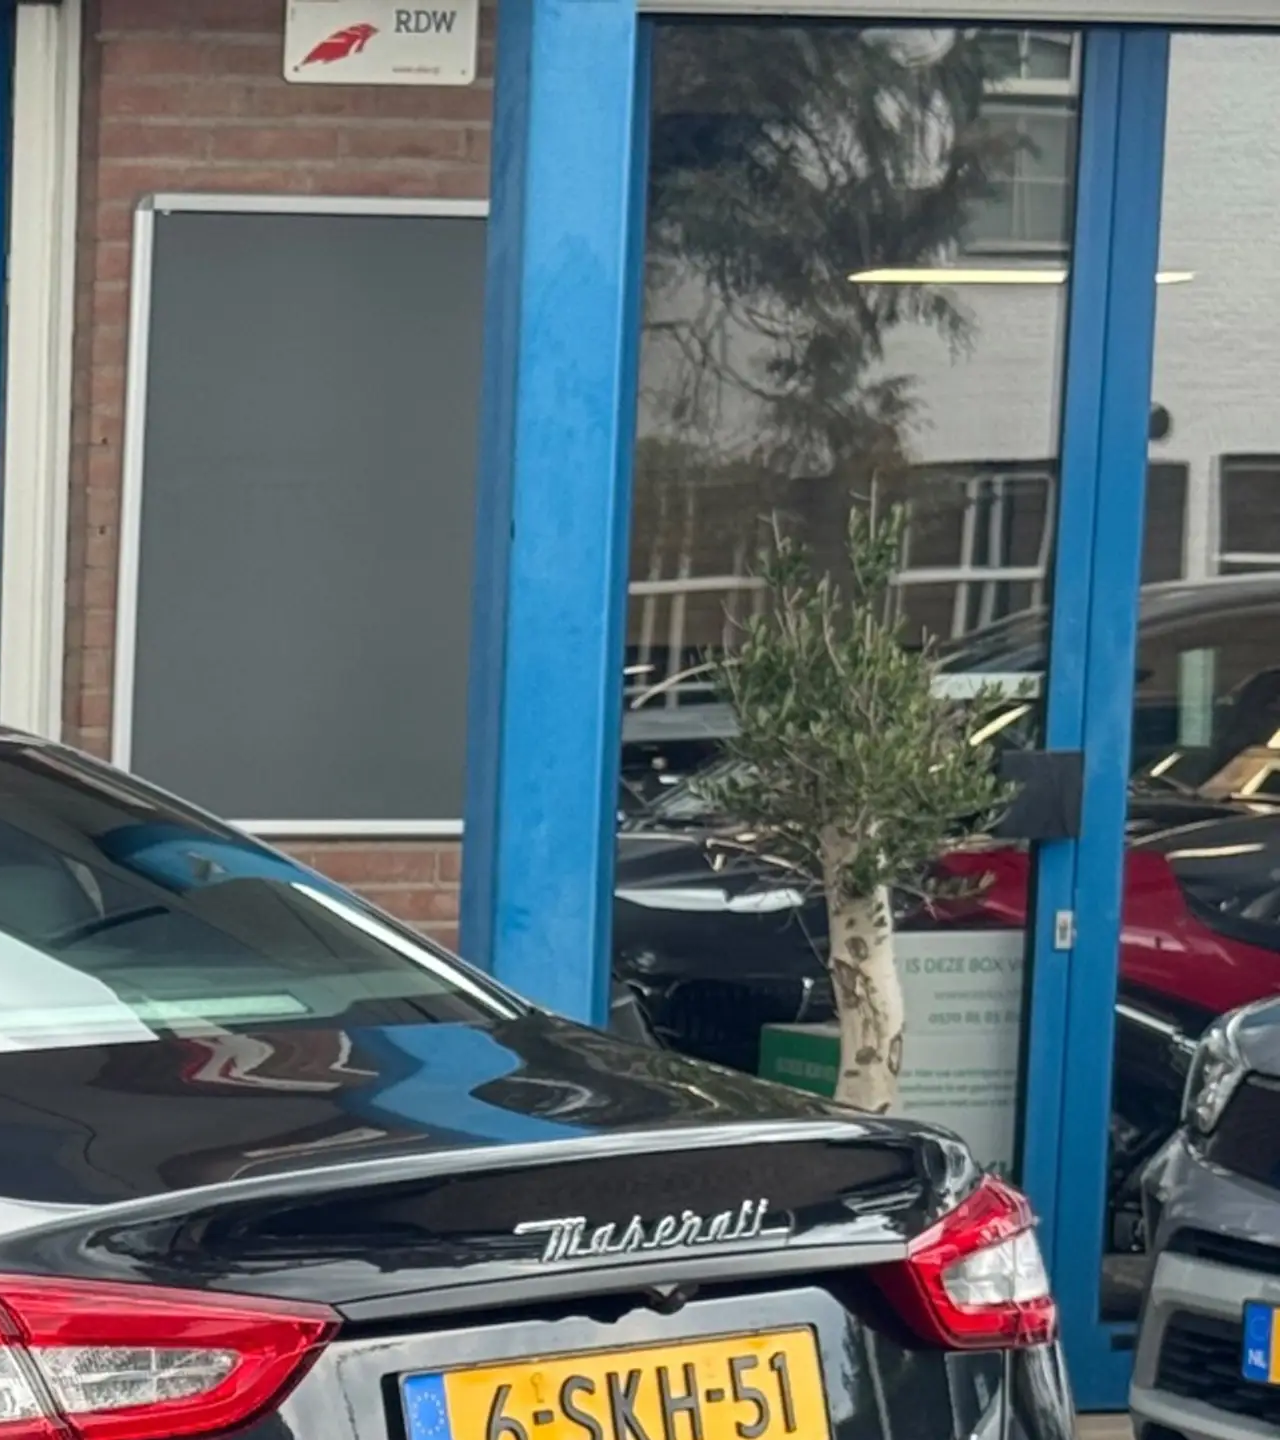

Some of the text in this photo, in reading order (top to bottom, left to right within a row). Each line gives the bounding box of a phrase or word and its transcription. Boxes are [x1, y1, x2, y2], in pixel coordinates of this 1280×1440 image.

[395, 9, 457, 33] RDW
[513, 1198, 790, 1264] Maserati
[1248, 1347, 1266, 1369] NL
